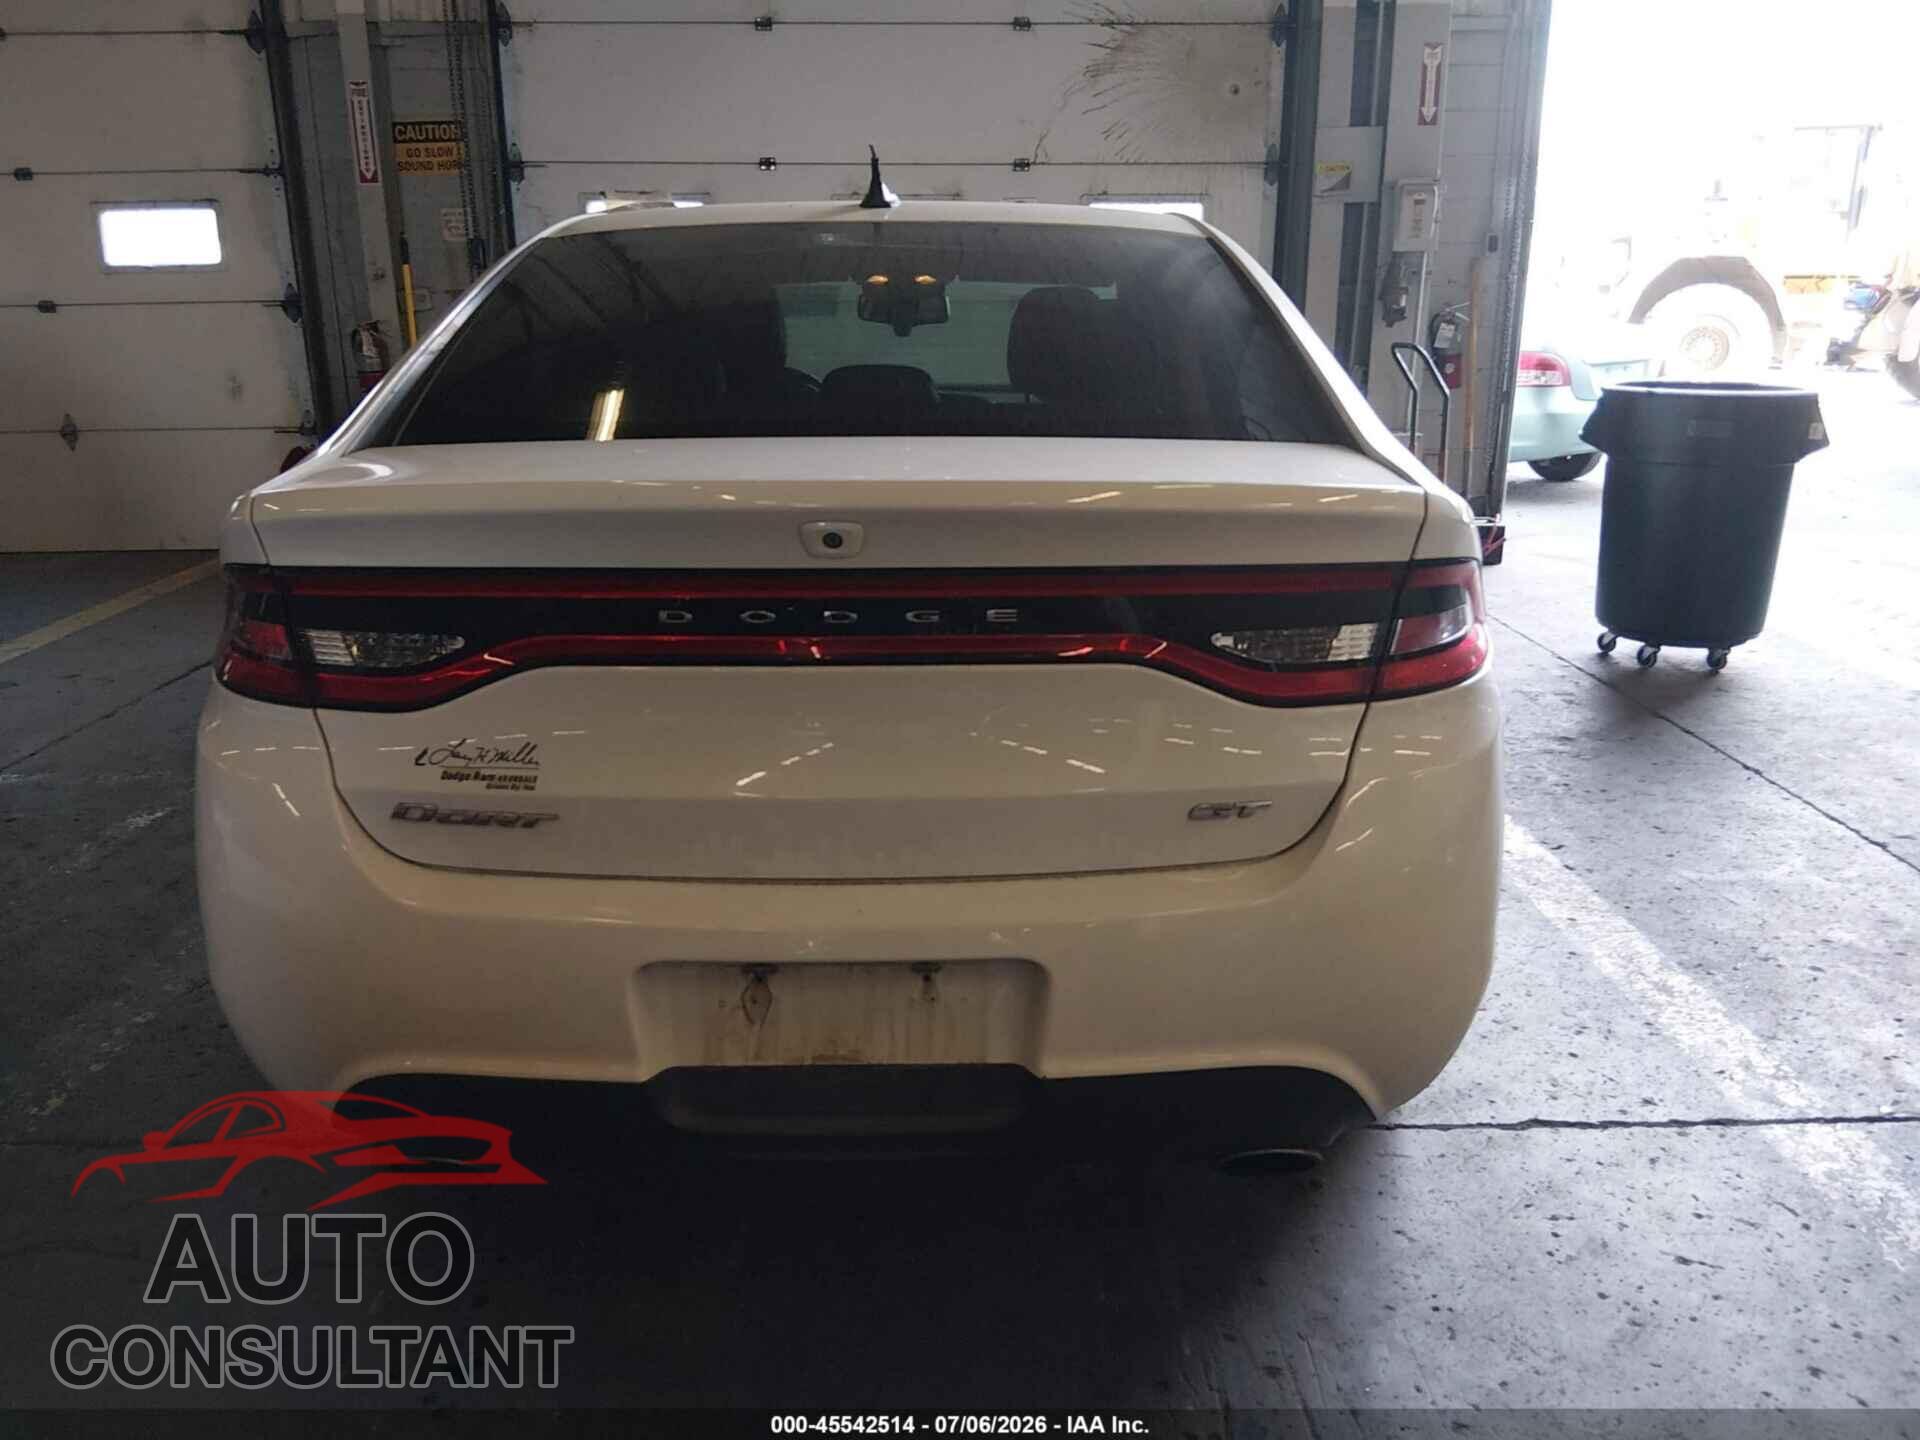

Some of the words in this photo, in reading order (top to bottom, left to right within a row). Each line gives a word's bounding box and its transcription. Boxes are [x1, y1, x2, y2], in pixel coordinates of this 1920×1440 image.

[394, 124, 462, 141] CAUTION
[406, 147, 421, 158] GO
[398, 160, 434, 171] SOUND
[658, 608, 1019, 624] DODGE
[441, 770, 471, 783] Dodge
[473, 770, 496, 782] Ram
[1187, 800, 1273, 821] GT
